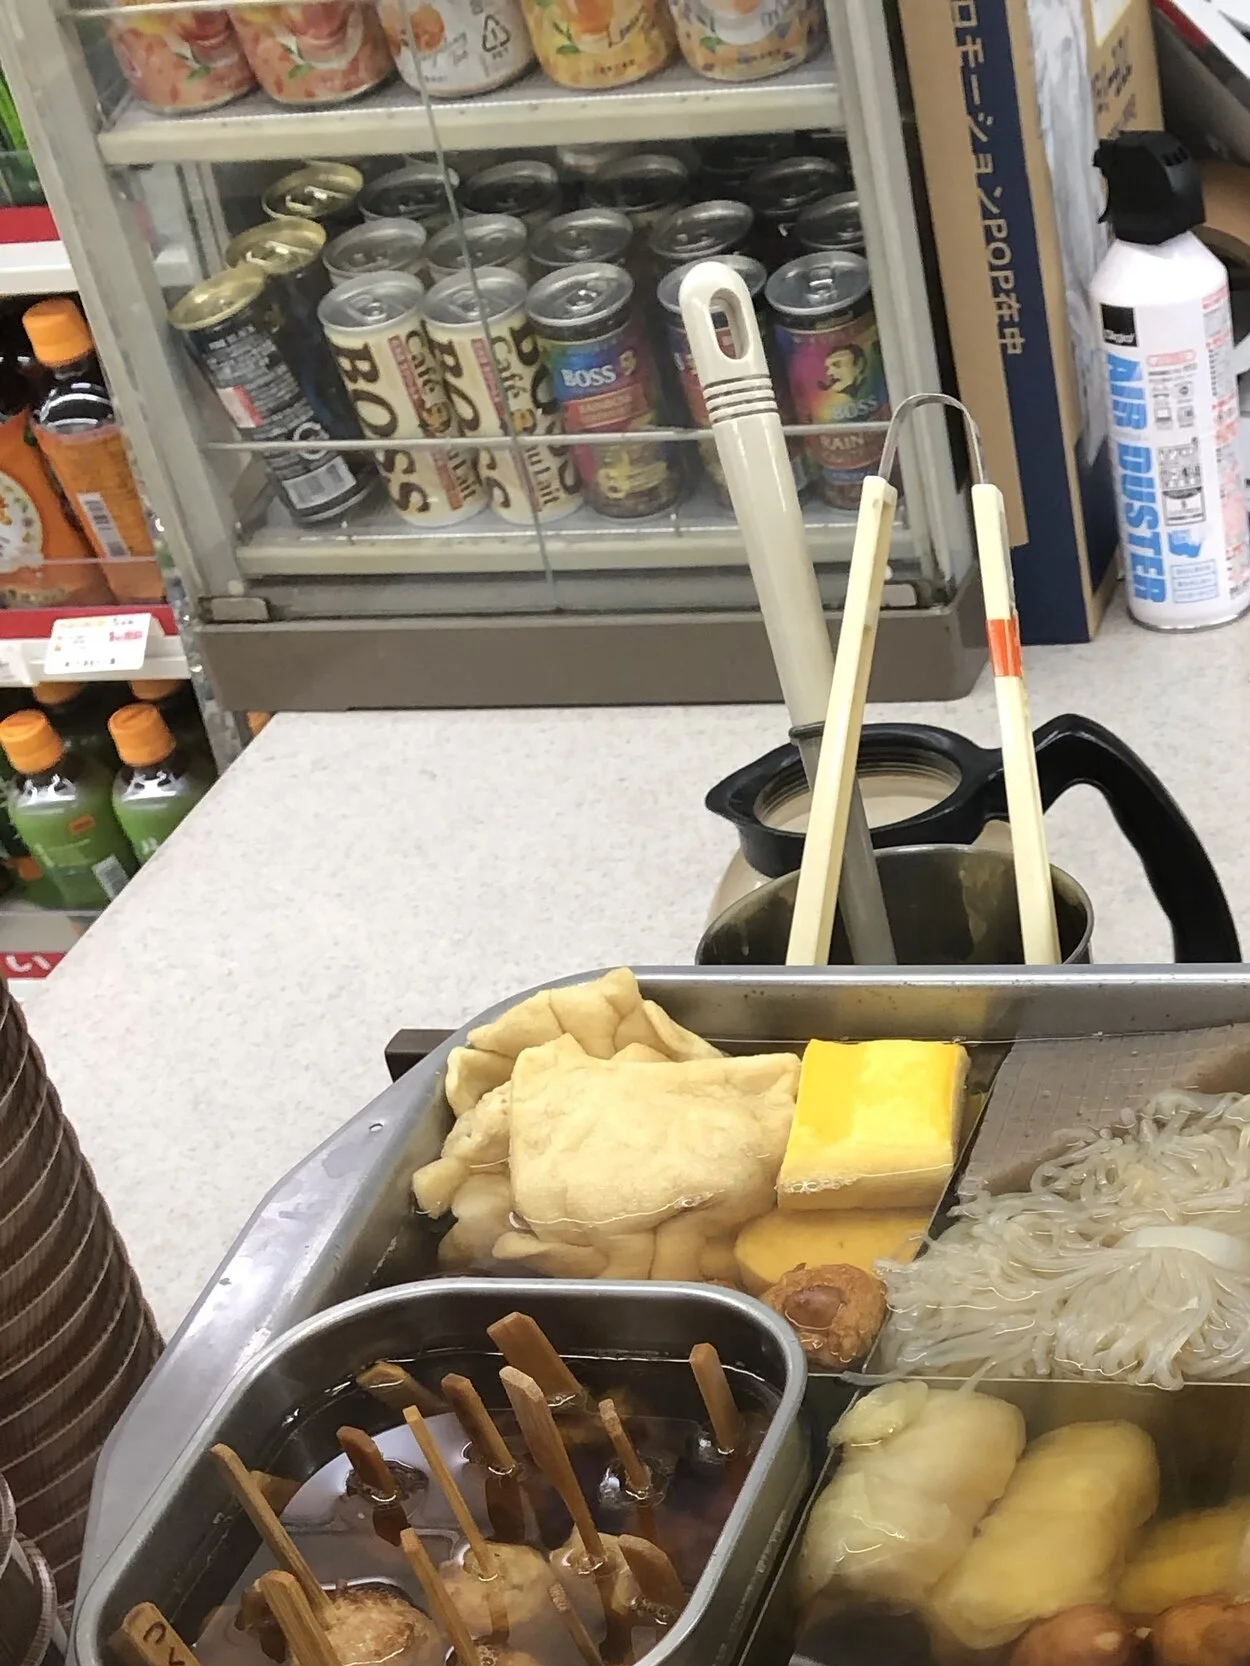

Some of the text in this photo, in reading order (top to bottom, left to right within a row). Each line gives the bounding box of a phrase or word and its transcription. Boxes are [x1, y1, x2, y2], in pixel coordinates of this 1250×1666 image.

[328, 340, 432, 513] BOSS
[560, 363, 618, 388] BOSS
[1107, 352, 1167, 603] AIR DUSTER
